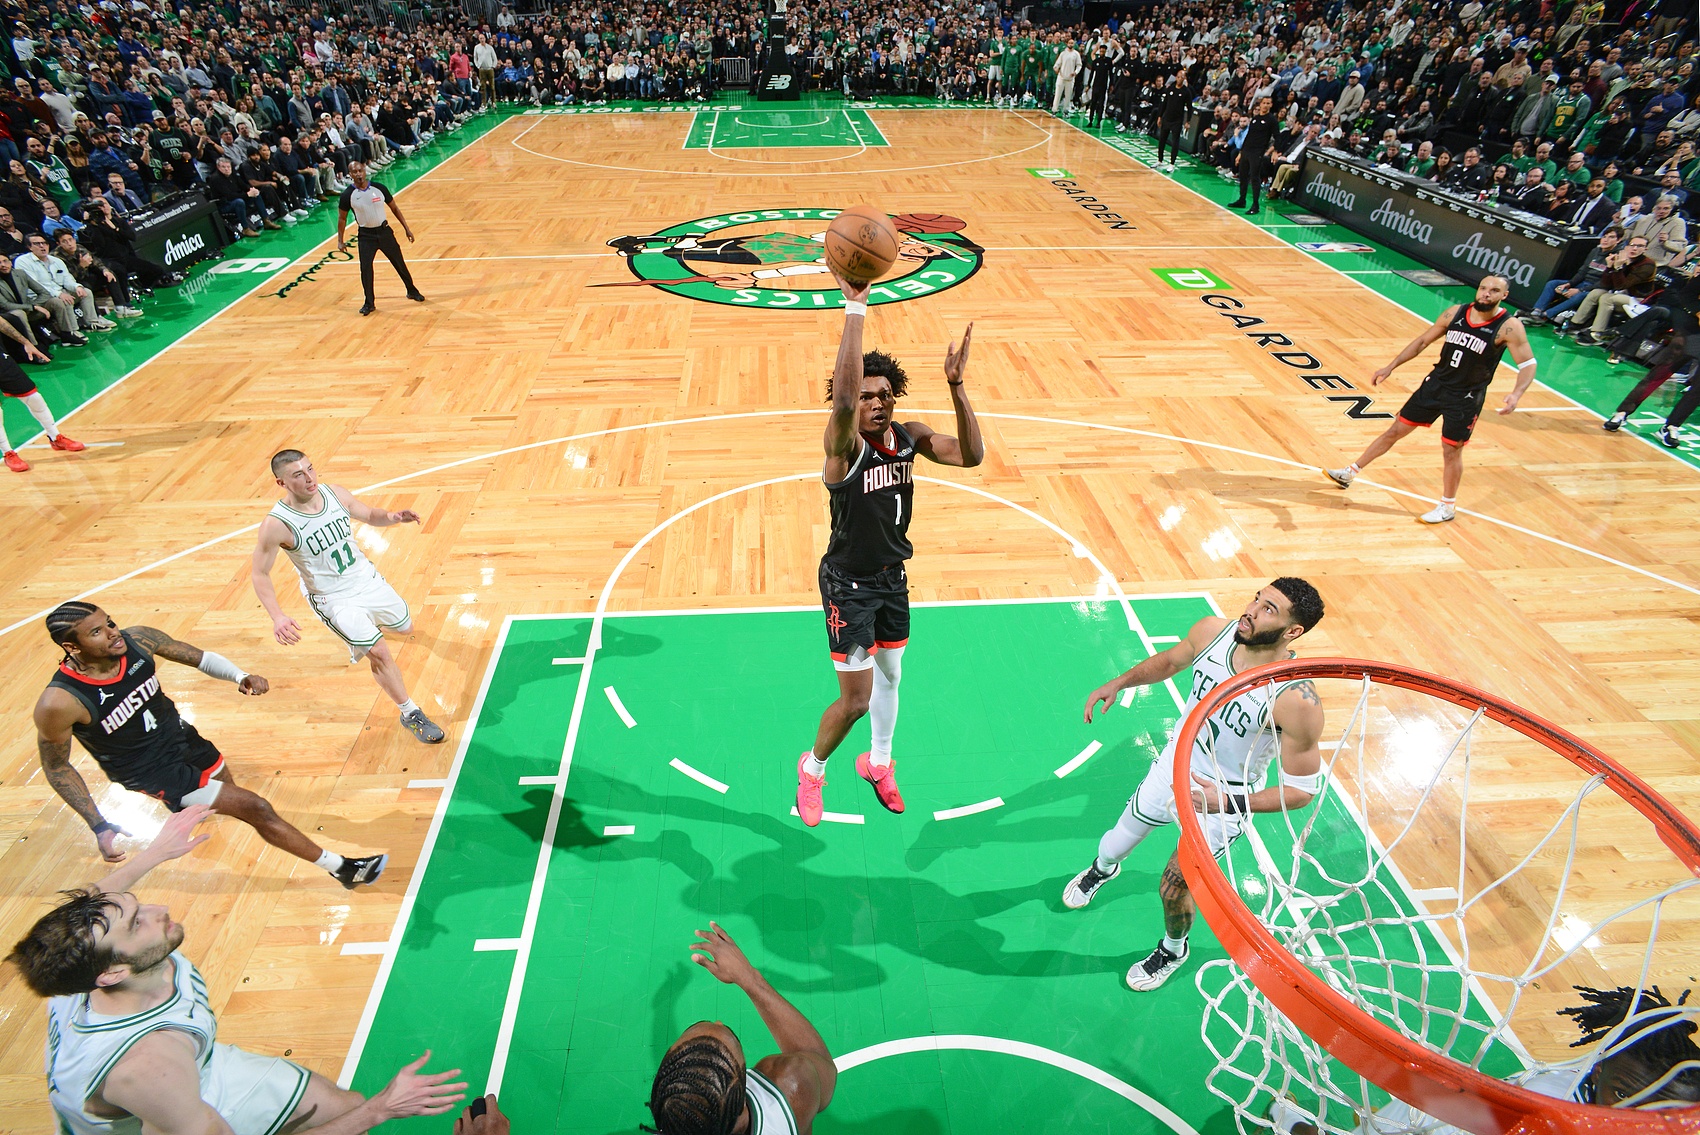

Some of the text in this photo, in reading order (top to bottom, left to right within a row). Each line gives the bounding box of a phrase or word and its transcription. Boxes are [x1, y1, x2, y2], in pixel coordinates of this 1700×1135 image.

[60, 179, 73, 192] 0
[693, 209, 842, 231] BOSTO
[1051, 180, 1138, 230] GARDEN
[1306, 171, 1356, 211] Amica
[1370, 198, 1434, 245] Amica
[1452, 232, 1536, 288] Amica
[164, 233, 205, 266] Amica
[730, 270, 958, 307] CELICS
[1167, 269, 1396, 420] TD GARDEN
[1446, 329, 1488, 355] HOUSTON
[1450, 349, 1464, 369] 9
[863, 461, 914, 494] HOUSTO
[894, 493, 903, 526] 1
[306, 515, 352, 557] CELTICS
[330, 541, 357, 575] 11
[1192, 669, 1252, 738] CEICS
[142, 708, 158, 733] 4
